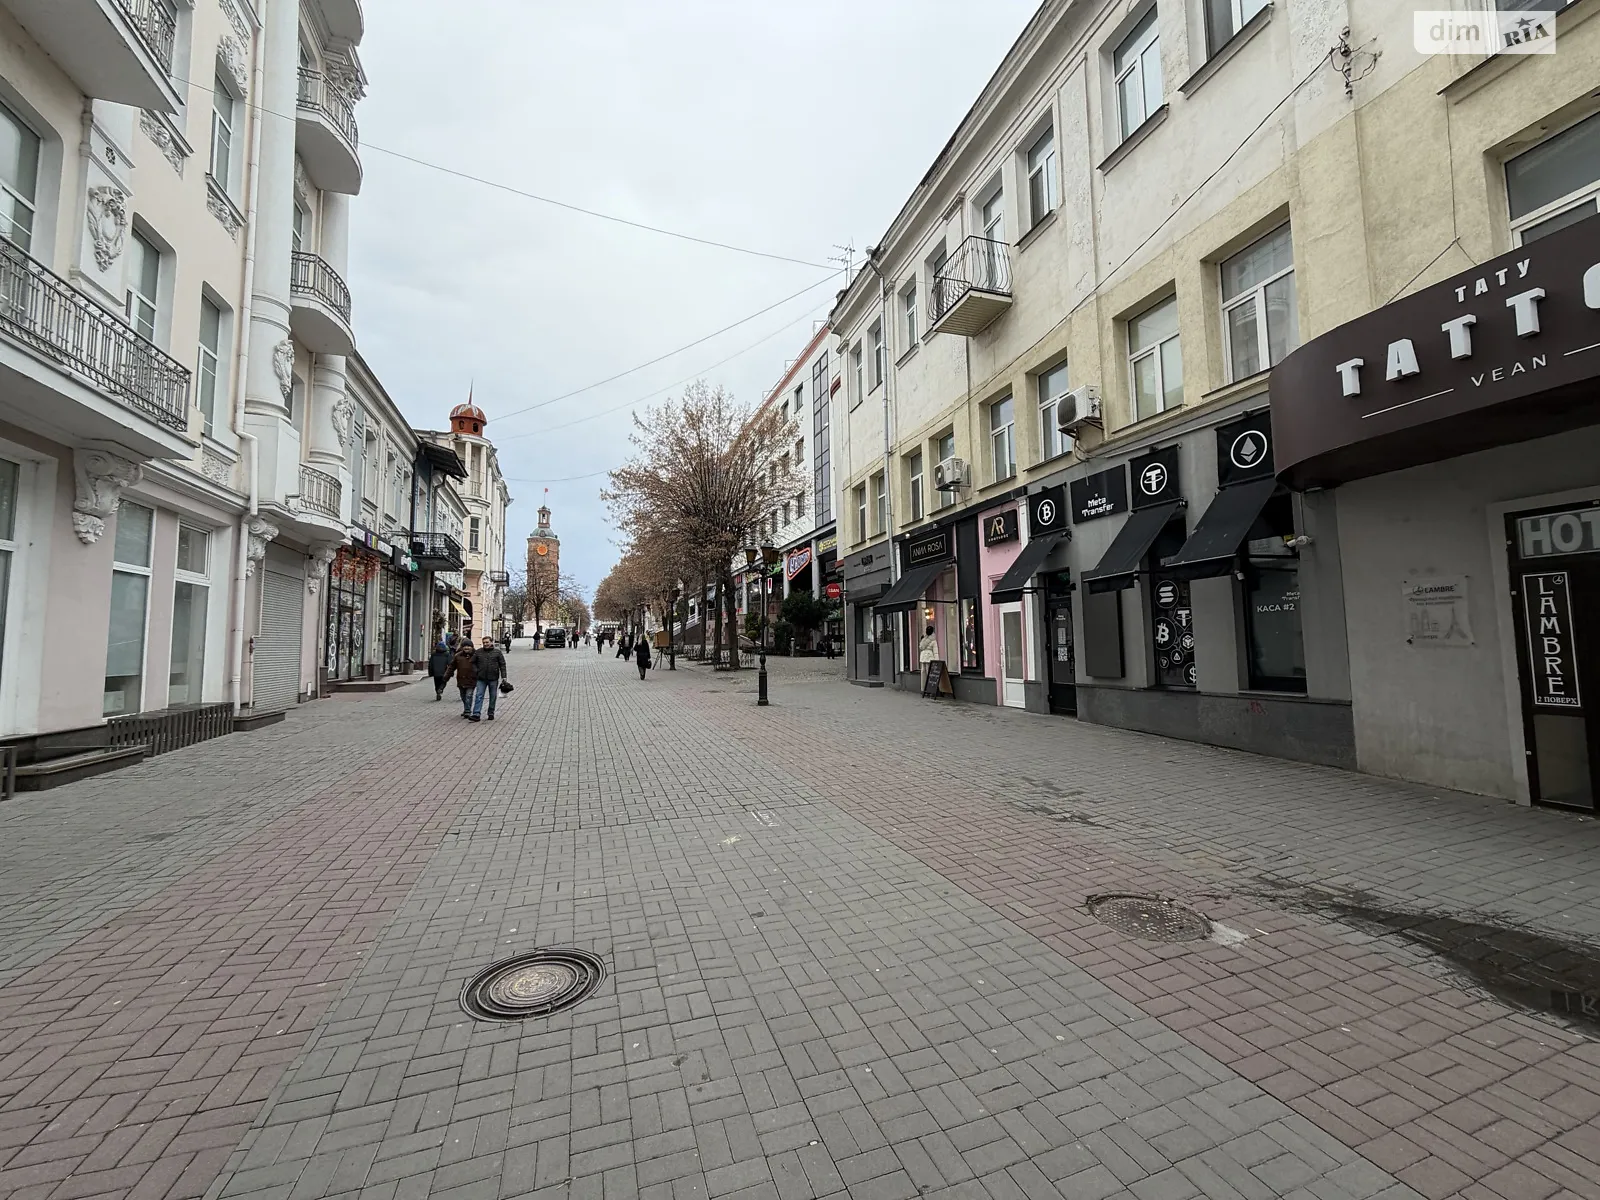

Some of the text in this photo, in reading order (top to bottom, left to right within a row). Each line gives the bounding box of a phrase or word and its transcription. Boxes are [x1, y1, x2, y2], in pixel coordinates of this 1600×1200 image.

[1470, 353, 1547, 388] VEAN
[1087, 497, 1107, 508] Meta
[1081, 503, 1115, 517] Transfer
[927, 540, 943, 553] ROSA
[1283, 603, 1295, 611] #2
[1537, 577, 1565, 696] LAMBRE
[1543, 696, 1577, 705] ПОВЕРХ
